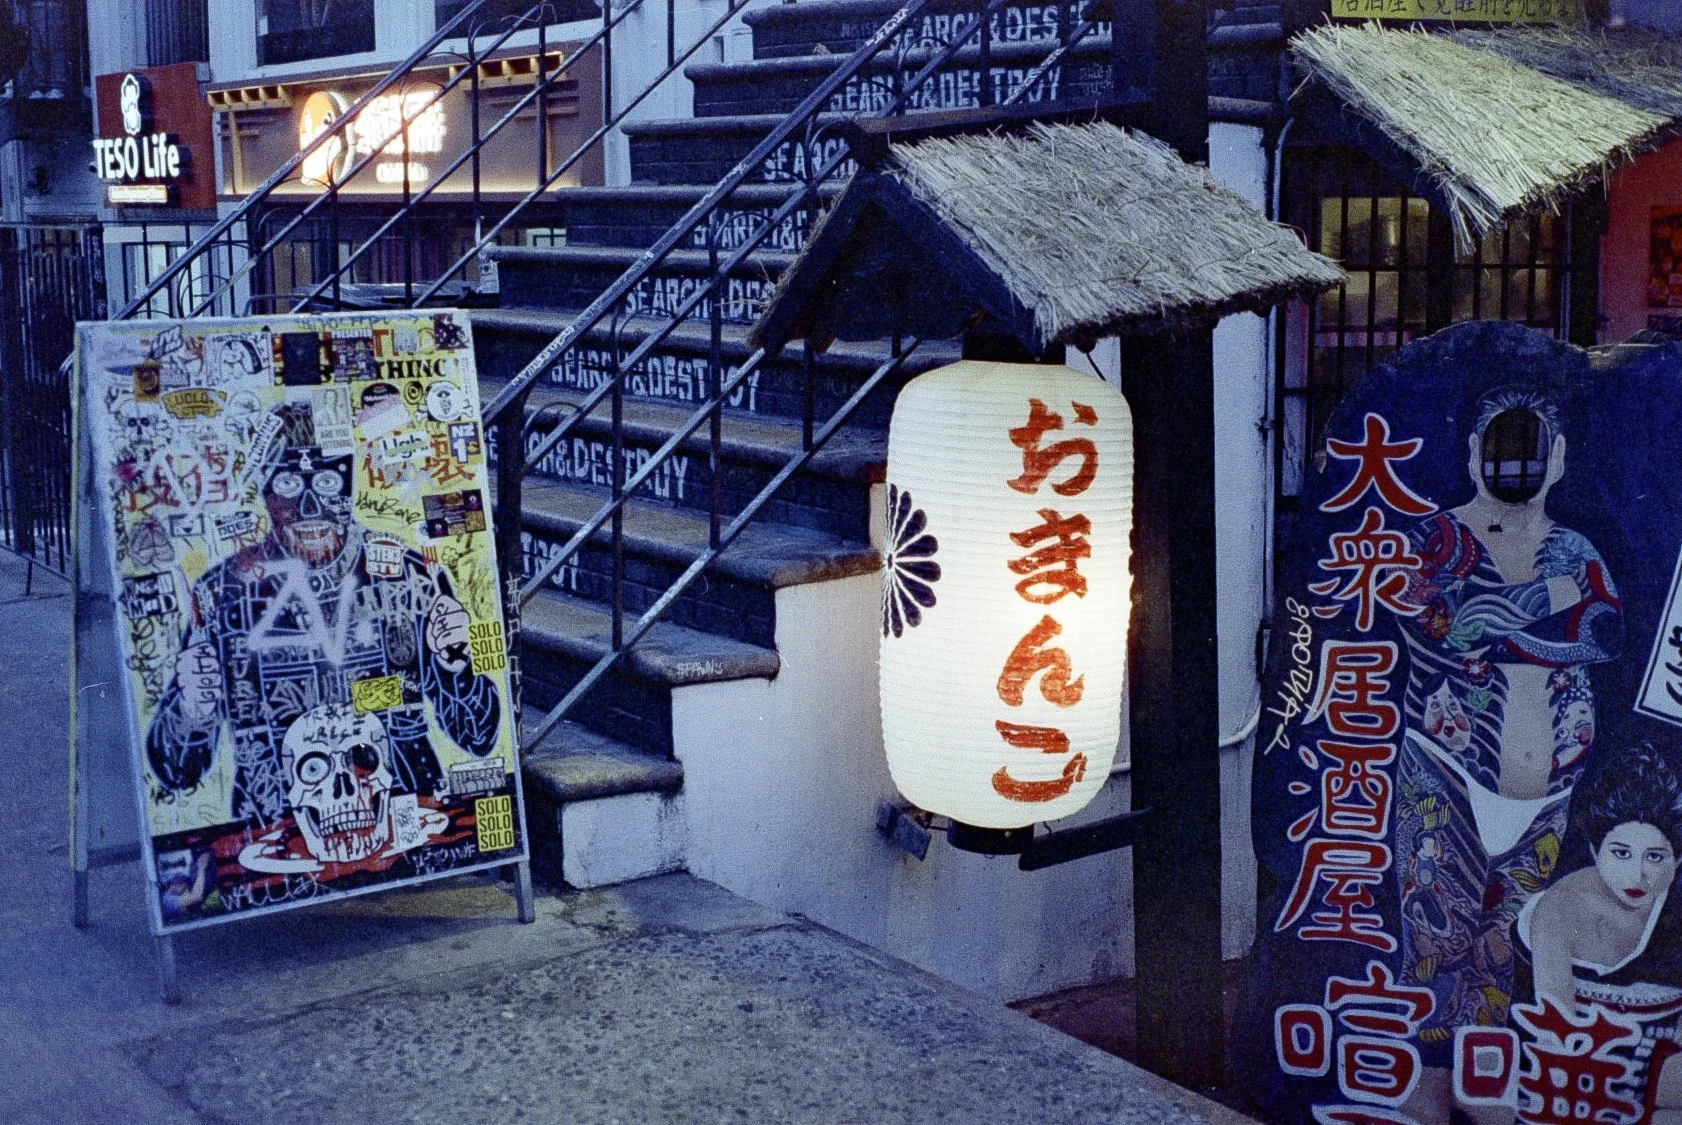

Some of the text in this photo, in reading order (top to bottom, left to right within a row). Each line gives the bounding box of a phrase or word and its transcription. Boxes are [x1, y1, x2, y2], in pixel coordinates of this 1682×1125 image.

[93, 132, 180, 181] TESO Life
[694, 208, 778, 248] SARCH
[648, 355, 761, 412] DESTOY
[992, 398, 1099, 803] おまんこ
[468, 621, 502, 640] SOLO
[470, 638, 504, 657] SOLO
[472, 656, 506, 674] SOLO
[1275, 411, 1440, 953] 大衆居酒屋
[477, 797, 510, 816] SOLO
[478, 814, 511, 833] SOLO
[480, 831, 512, 849] SOLO
